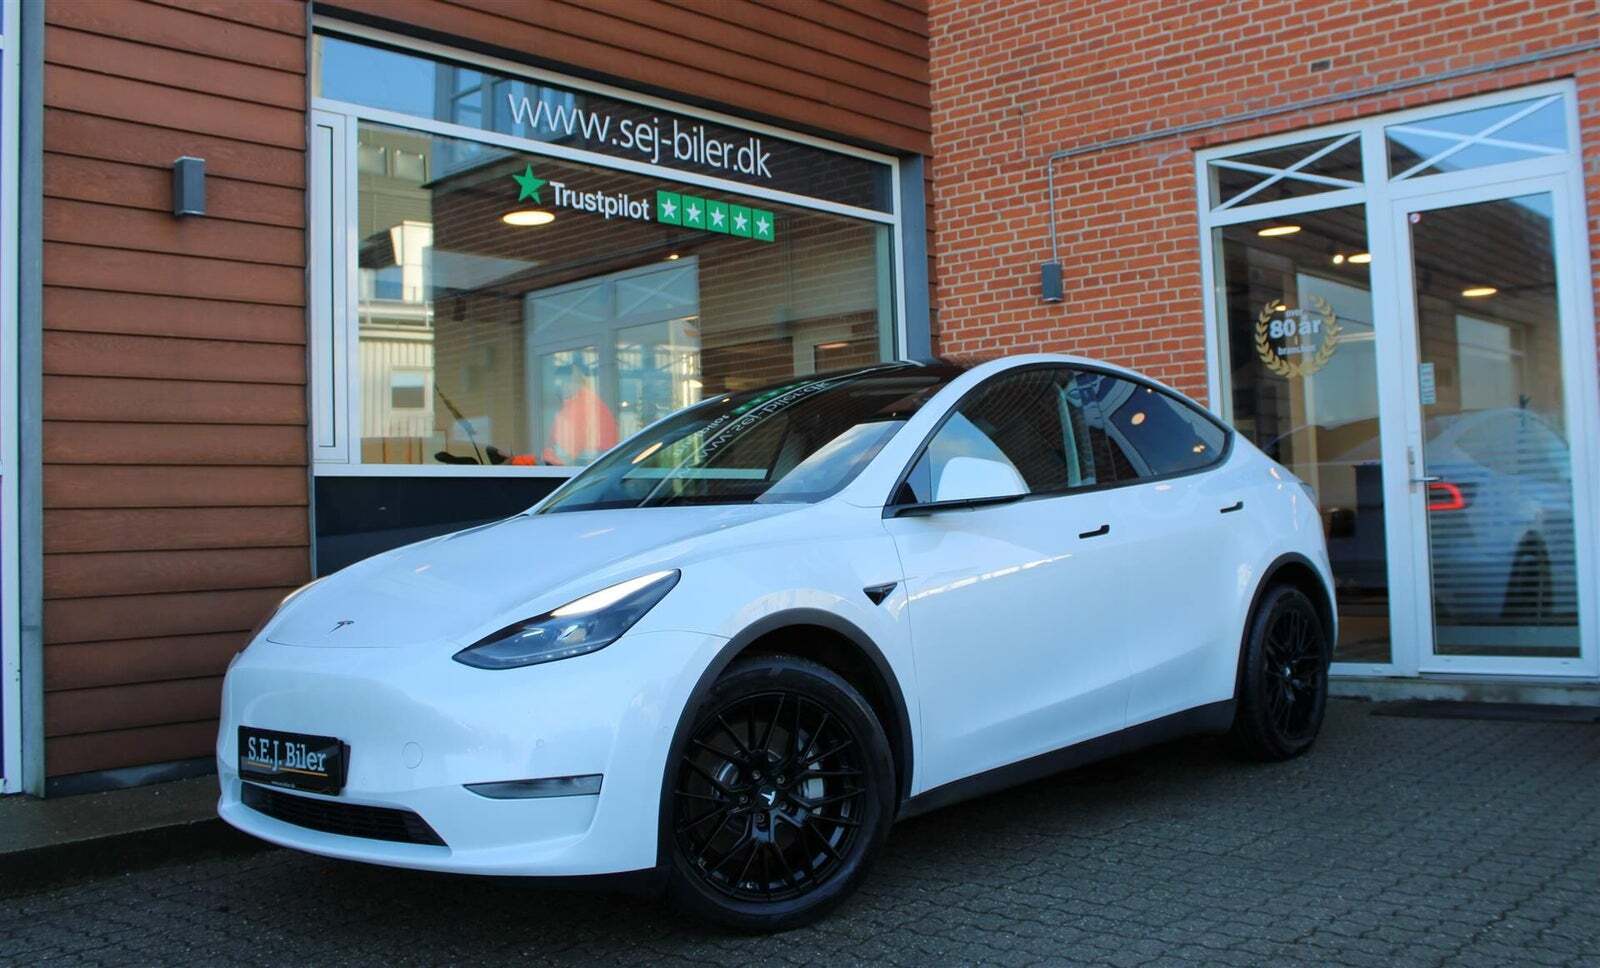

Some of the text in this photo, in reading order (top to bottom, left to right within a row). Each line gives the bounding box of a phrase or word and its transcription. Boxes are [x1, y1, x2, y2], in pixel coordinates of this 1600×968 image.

[508, 93, 772, 178] www.sej-biler.dk
[549, 180, 650, 221] Trustpilot
[1269, 318, 1296, 338] 80
[248, 736, 327, 772] S.E.J. Biler
